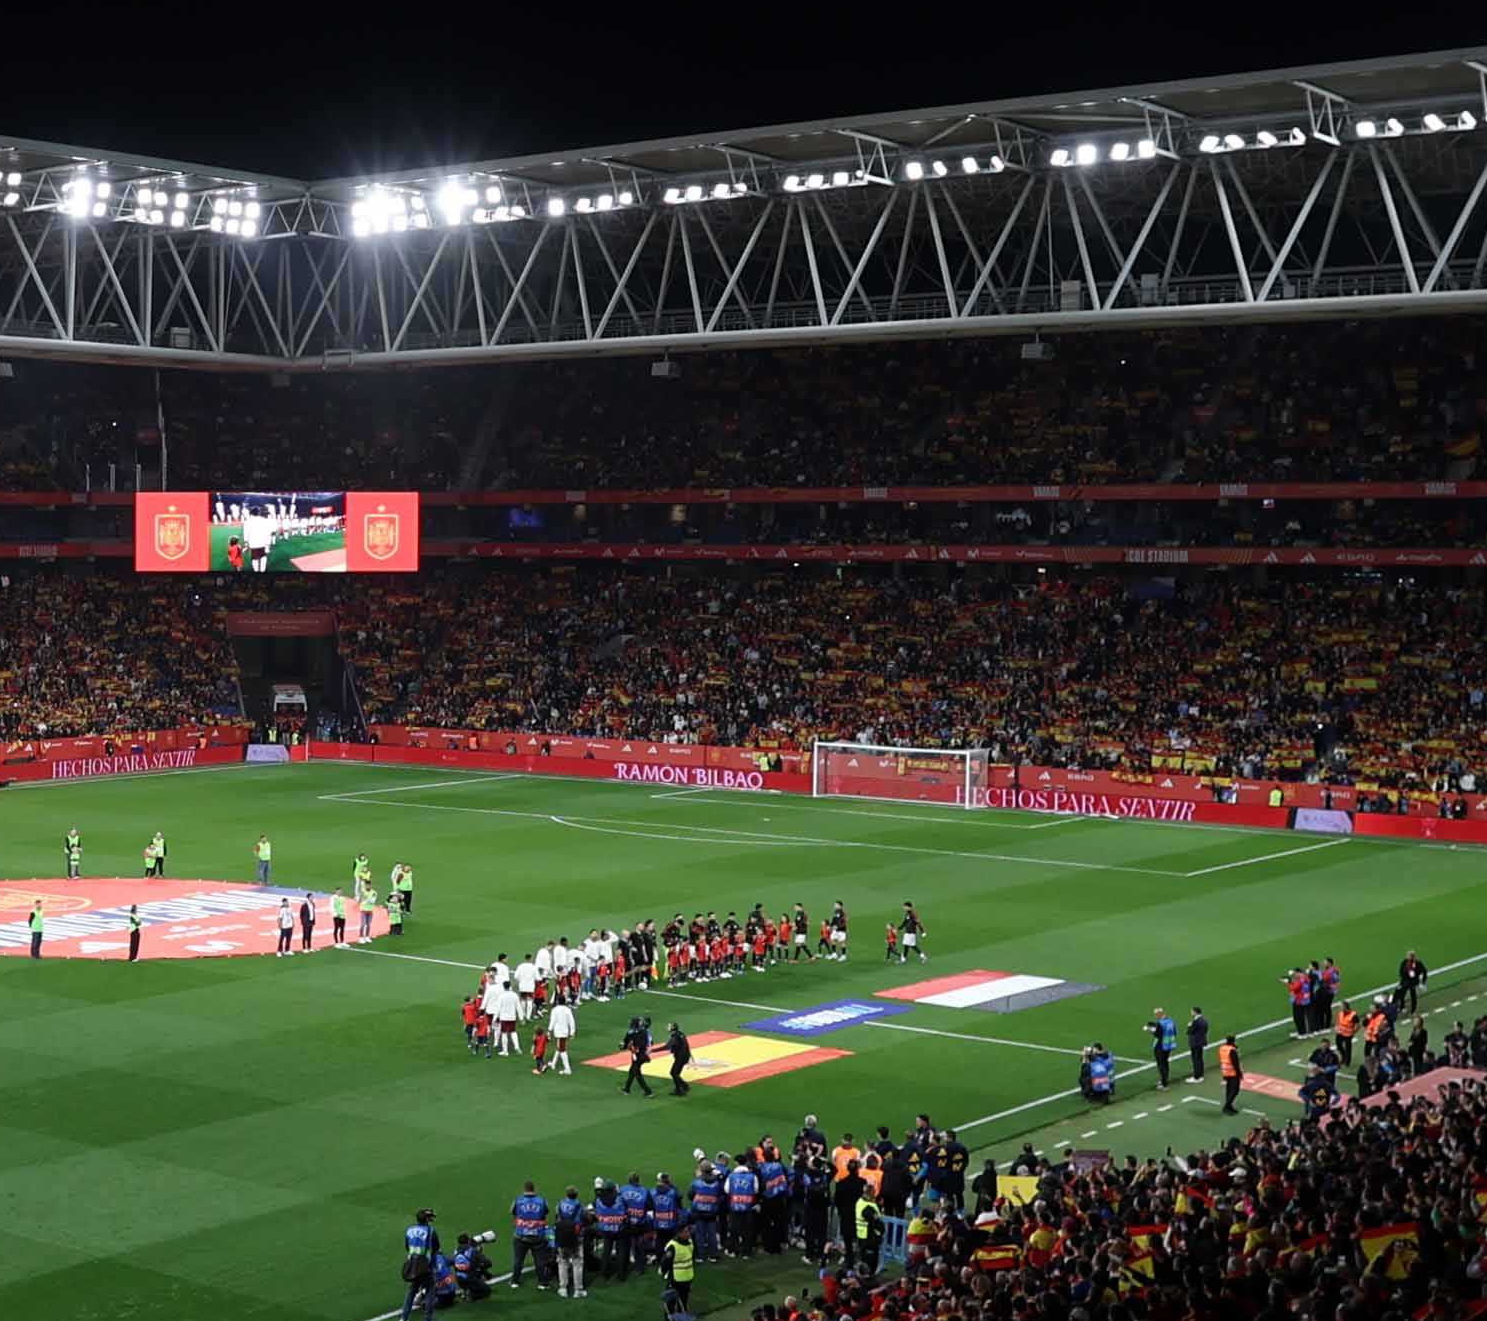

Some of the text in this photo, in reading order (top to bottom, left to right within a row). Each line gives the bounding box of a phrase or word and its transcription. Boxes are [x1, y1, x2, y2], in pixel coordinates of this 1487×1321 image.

[52, 749, 197, 779] HECHOS PARA SENTIR
[691, 767, 764, 791] BILBAO
[955, 784, 1197, 822] HECHOS PARA SENTIR
